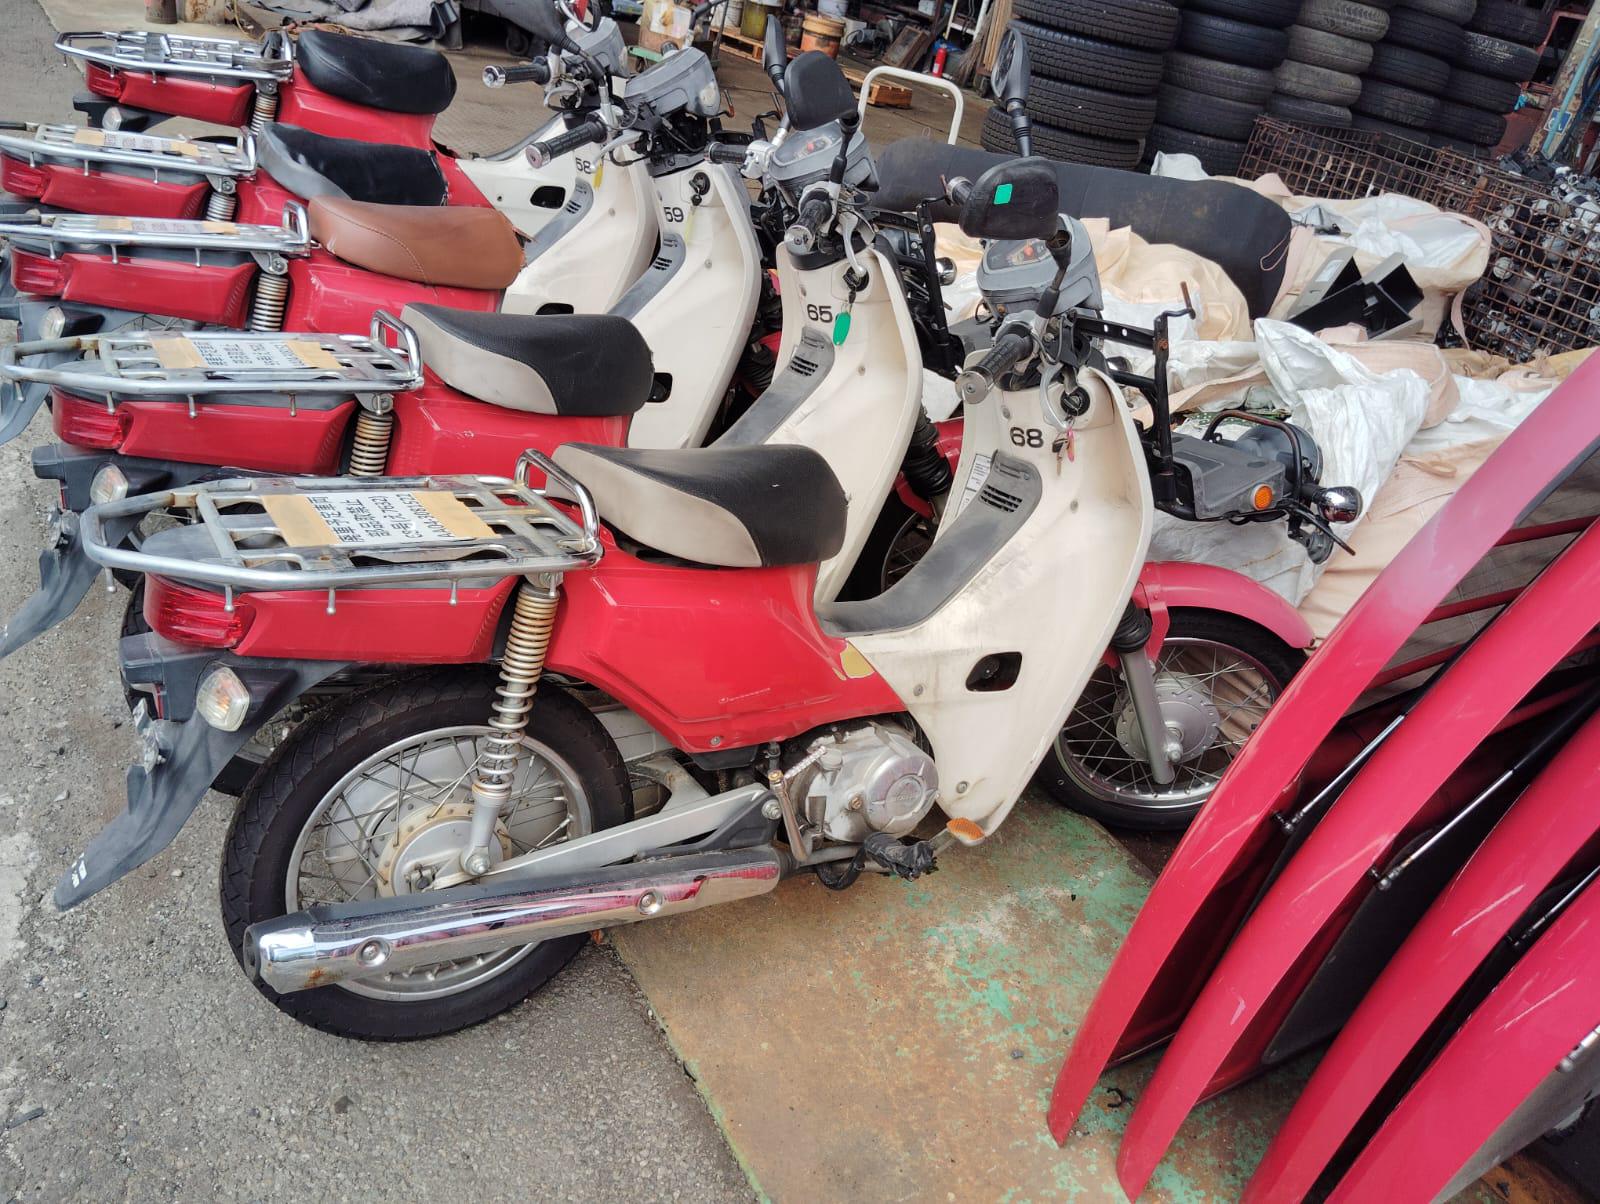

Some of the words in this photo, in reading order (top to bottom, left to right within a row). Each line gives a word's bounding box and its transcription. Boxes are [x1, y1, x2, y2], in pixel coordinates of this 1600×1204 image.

[575, 157, 591, 174] 58
[663, 206, 684, 223] 59
[807, 304, 833, 323] 65
[1010, 427, 1043, 448] 68
